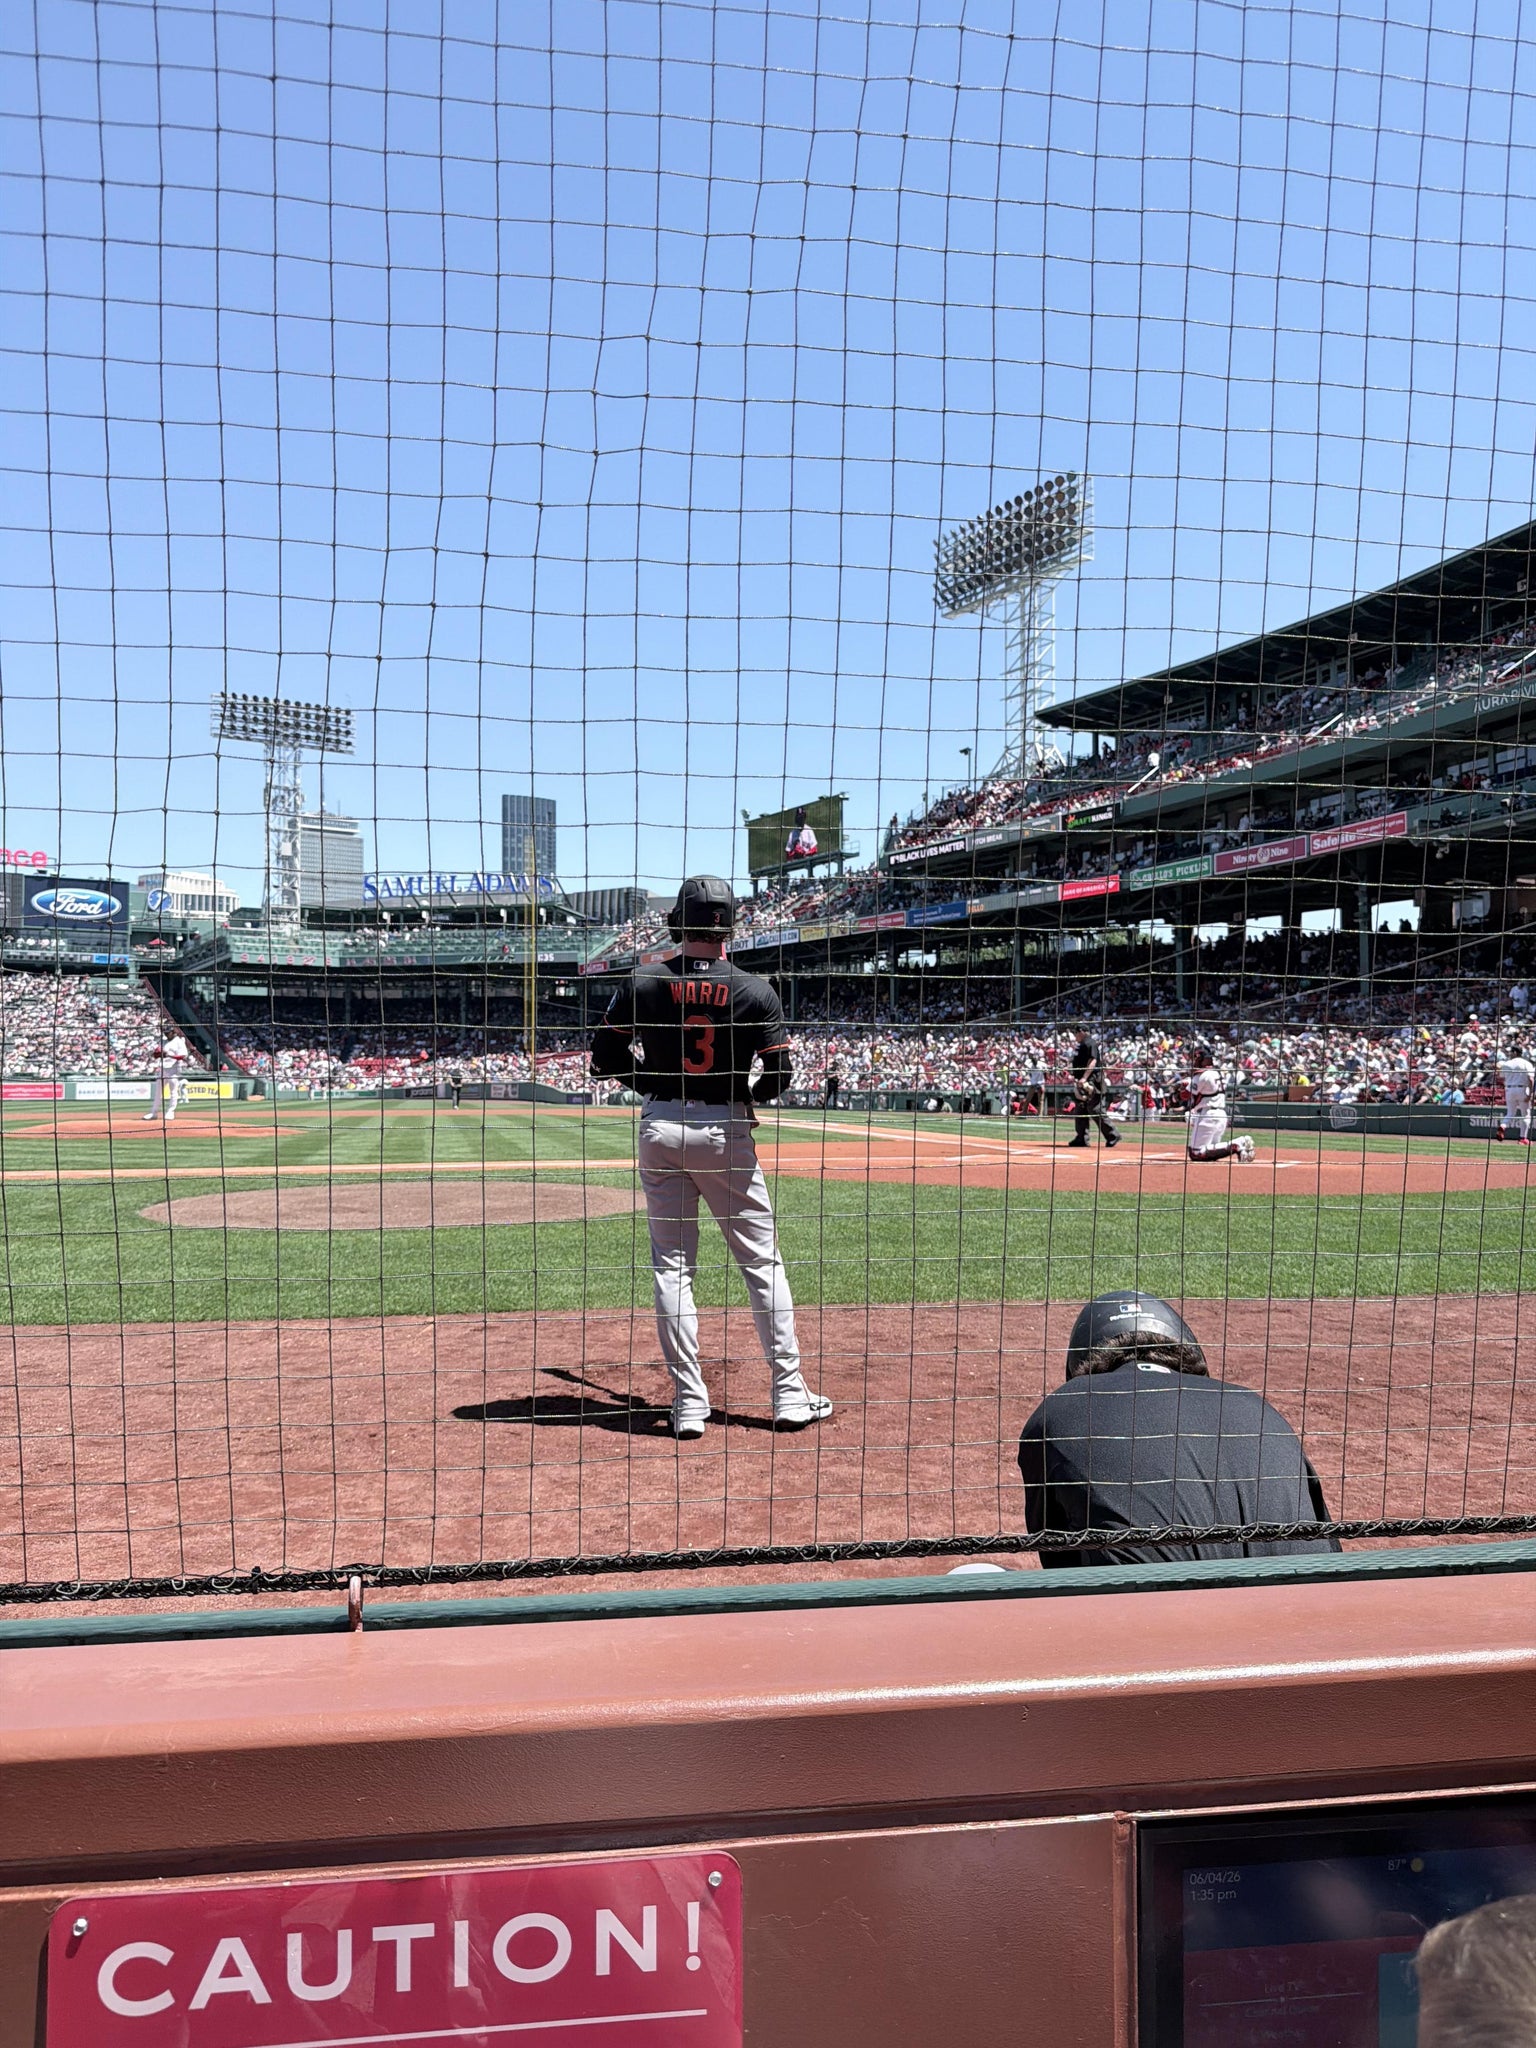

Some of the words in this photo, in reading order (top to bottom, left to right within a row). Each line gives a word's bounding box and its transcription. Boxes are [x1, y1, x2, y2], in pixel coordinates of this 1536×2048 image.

[1511, 683, 1536, 701] PAVI
[899, 850, 919, 863] BLACK
[920, 846, 938, 858] LIVES
[939, 841, 965, 854] MATTER
[1233, 851, 1256, 865] Ninety
[1270, 846, 1289, 857] Nine
[1176, 860, 1209, 877] PICKLES
[363, 873, 462, 901] SAMUEL
[49, 892, 103, 914] Ford
[714, 912, 721, 923] 3
[669, 982, 729, 1007] WARD
[681, 1014, 715, 1074] 3
[184, 1086, 207, 1095] ISTED
[1388, 1858, 1407, 1871] 87°
[1189, 1870, 1241, 1886] 06/04/26
[1190, 1888, 1215, 1902] 1:35
[1217, 1889, 1237, 1903] pm
[97, 1901, 703, 2017] CAUTION!
